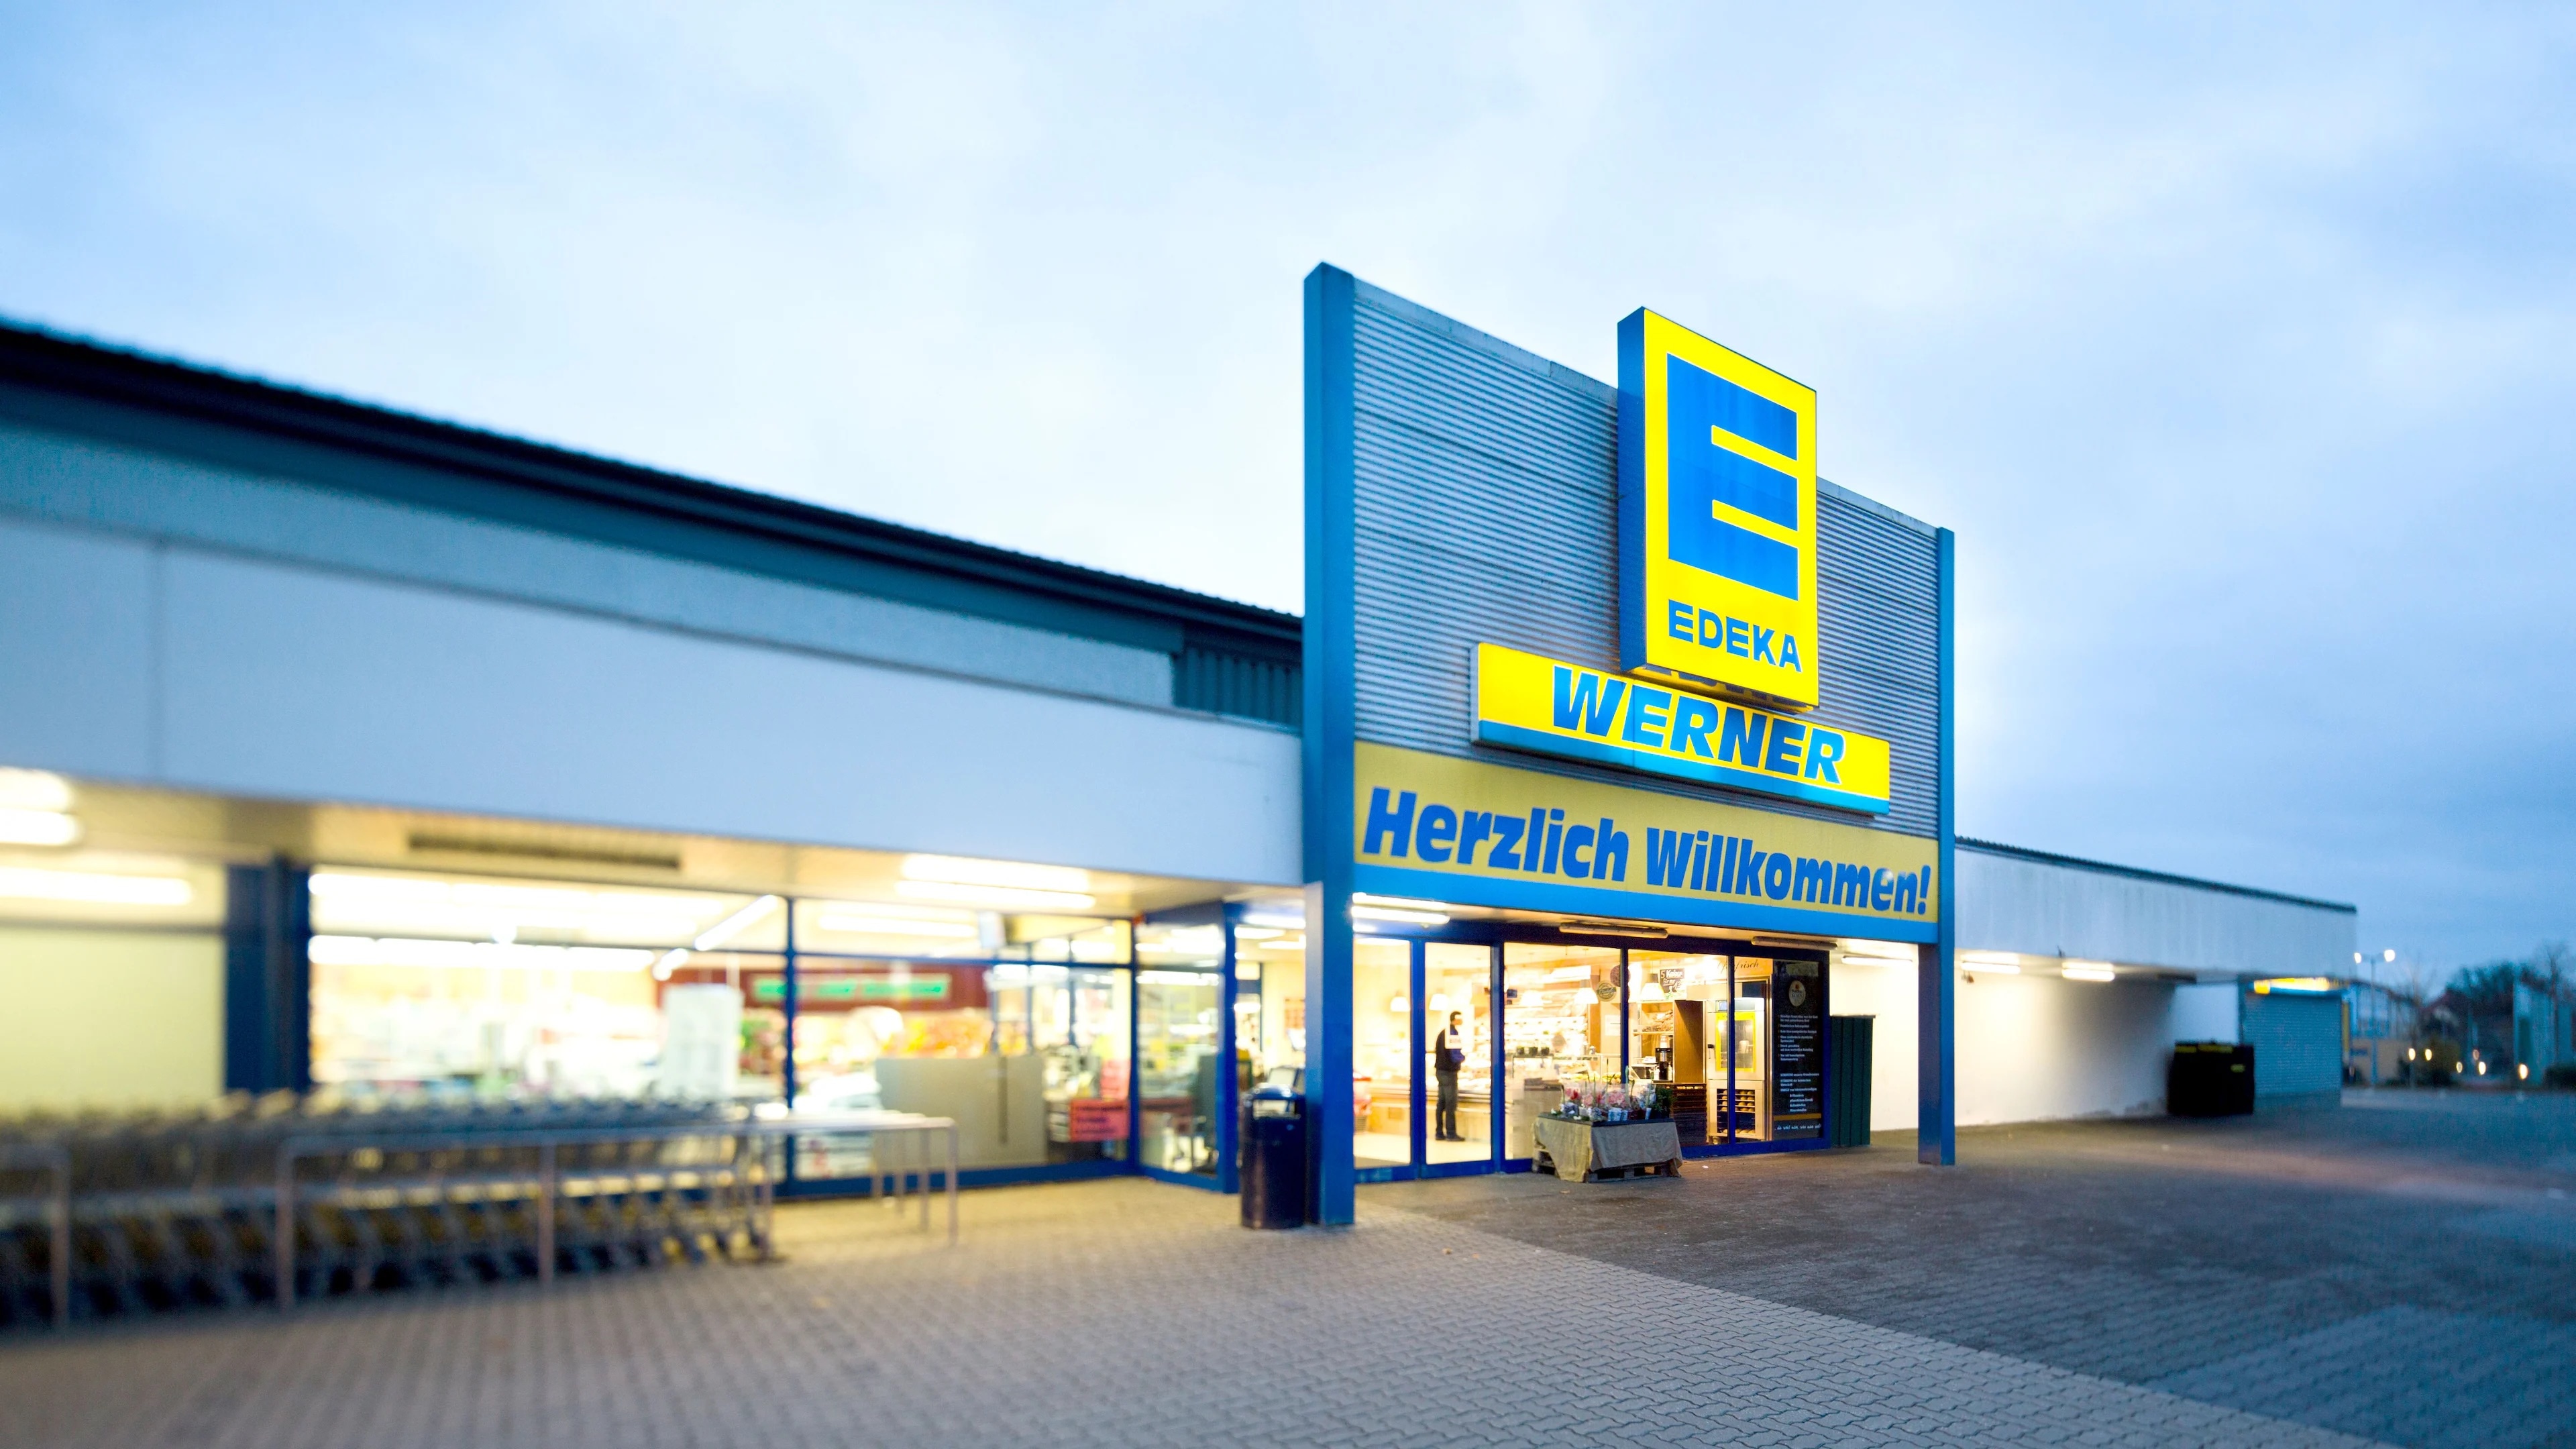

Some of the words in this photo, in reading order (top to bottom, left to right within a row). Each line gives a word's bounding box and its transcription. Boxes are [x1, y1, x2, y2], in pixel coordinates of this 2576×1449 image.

[1667, 352, 1799, 602] E
[1668, 599, 1803, 673] EDEKA
[1553, 665, 1846, 784] WERNER
[1362, 787, 1629, 881] Herzlich
[1646, 827, 1931, 915] Willkommen!
